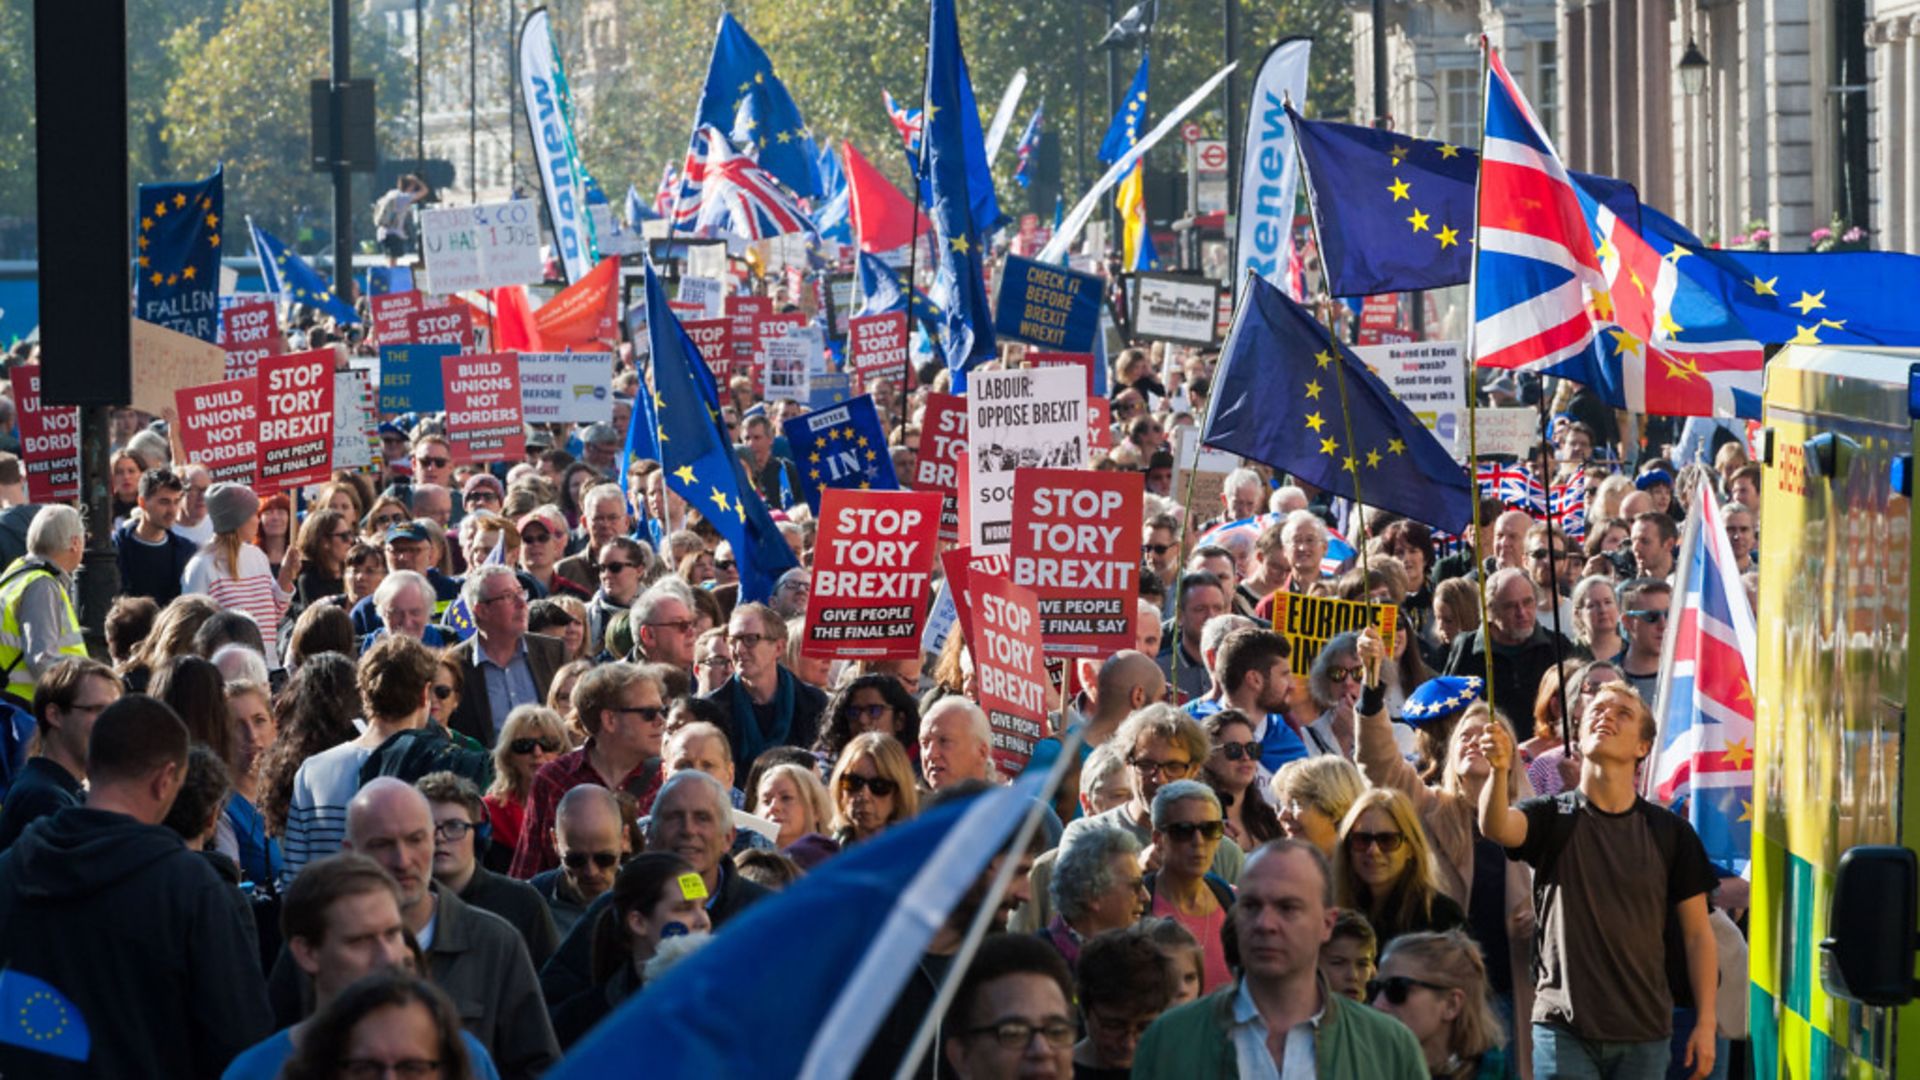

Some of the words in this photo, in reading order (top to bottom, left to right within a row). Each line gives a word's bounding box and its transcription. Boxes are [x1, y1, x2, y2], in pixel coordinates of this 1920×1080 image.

[1246, 90, 1287, 278] Renew
[473, 206, 488, 225] &
[496, 204, 527, 224] CO
[428, 235, 442, 253] U
[505, 225, 537, 246] JOB
[1026, 266, 1064, 288] CHECK
[1067, 278, 1081, 293] IT
[146, 290, 215, 320] FALLEN
[1025, 285, 1074, 311] BEFORE
[231, 310, 269, 329] STOP
[417, 314, 461, 334] STOP
[1024, 303, 1068, 327] BREXIT
[160, 317, 211, 338] TAR
[231, 324, 270, 343] TORY
[858, 319, 897, 338] STOP
[1019, 321, 1065, 345] WREXIT
[858, 334, 899, 352] TORY
[1431, 347, 1457, 357] Brexit
[386, 351, 409, 363] THE
[268, 363, 324, 391] STOP
[383, 373, 411, 385] BEST
[458, 362, 502, 377] BUILD
[521, 373, 554, 384] CHECK
[556, 373, 567, 384] IT
[451, 376, 513, 394] UNIONS
[522, 389, 562, 399] BEFORE
[977, 375, 1034, 401] LABOUR:
[194, 390, 243, 411] BUILD
[268, 388, 325, 416] TORY
[382, 396, 411, 408] DEAL
[466, 393, 500, 408] NOT
[524, 406, 560, 416] BREXIT
[187, 405, 257, 430] UNIONS
[450, 408, 519, 425] BORDERS
[811, 410, 847, 428] BETTER
[938, 409, 968, 434] ST
[977, 404, 1029, 429] OPPOSE
[1032, 400, 1080, 425] BREXIT
[206, 425, 243, 444] NOT
[259, 412, 332, 443] BREXIT
[451, 430, 470, 441] FREE
[471, 426, 521, 439] MOVEMENT
[25, 432, 78, 453] BORDE
[189, 441, 257, 464] BORDER
[267, 446, 291, 462] GIVE
[291, 440, 325, 457] PEOPLE
[470, 440, 487, 450] FOR
[488, 438, 504, 448] ALL
[933, 436, 968, 461] TO
[28, 461, 50, 473] FREE
[263, 464, 280, 476] THE
[281, 459, 309, 474] FINAL
[310, 454, 328, 467] SAY
[826, 448, 861, 481] IN
[1032, 487, 1124, 519] STOP
[836, 507, 922, 536] STOP
[1028, 522, 1123, 554] TORY
[831, 539, 919, 567] TORY
[1014, 557, 1136, 590] BREXIT
[814, 571, 928, 599] BREXIT
[822, 608, 858, 622] GIVE
[860, 606, 912, 621] PEOPLE
[982, 592, 1031, 636] STOP
[1038, 600, 1061, 614] IVE
[1065, 600, 1121, 614] PEOPLE
[814, 626, 841, 639] THE
[844, 624, 885, 639] FINAL
[888, 623, 915, 637] SAY
[1049, 619, 1093, 634] FINAL
[1097, 620, 1127, 634] SAY
[984, 628, 1034, 674] TORY
[980, 662, 1044, 715] BREXIT
[991, 711, 1011, 730] GIVE
[1012, 716, 1041, 738] PEOPLE
[1005, 734, 1029, 755] FINAL
